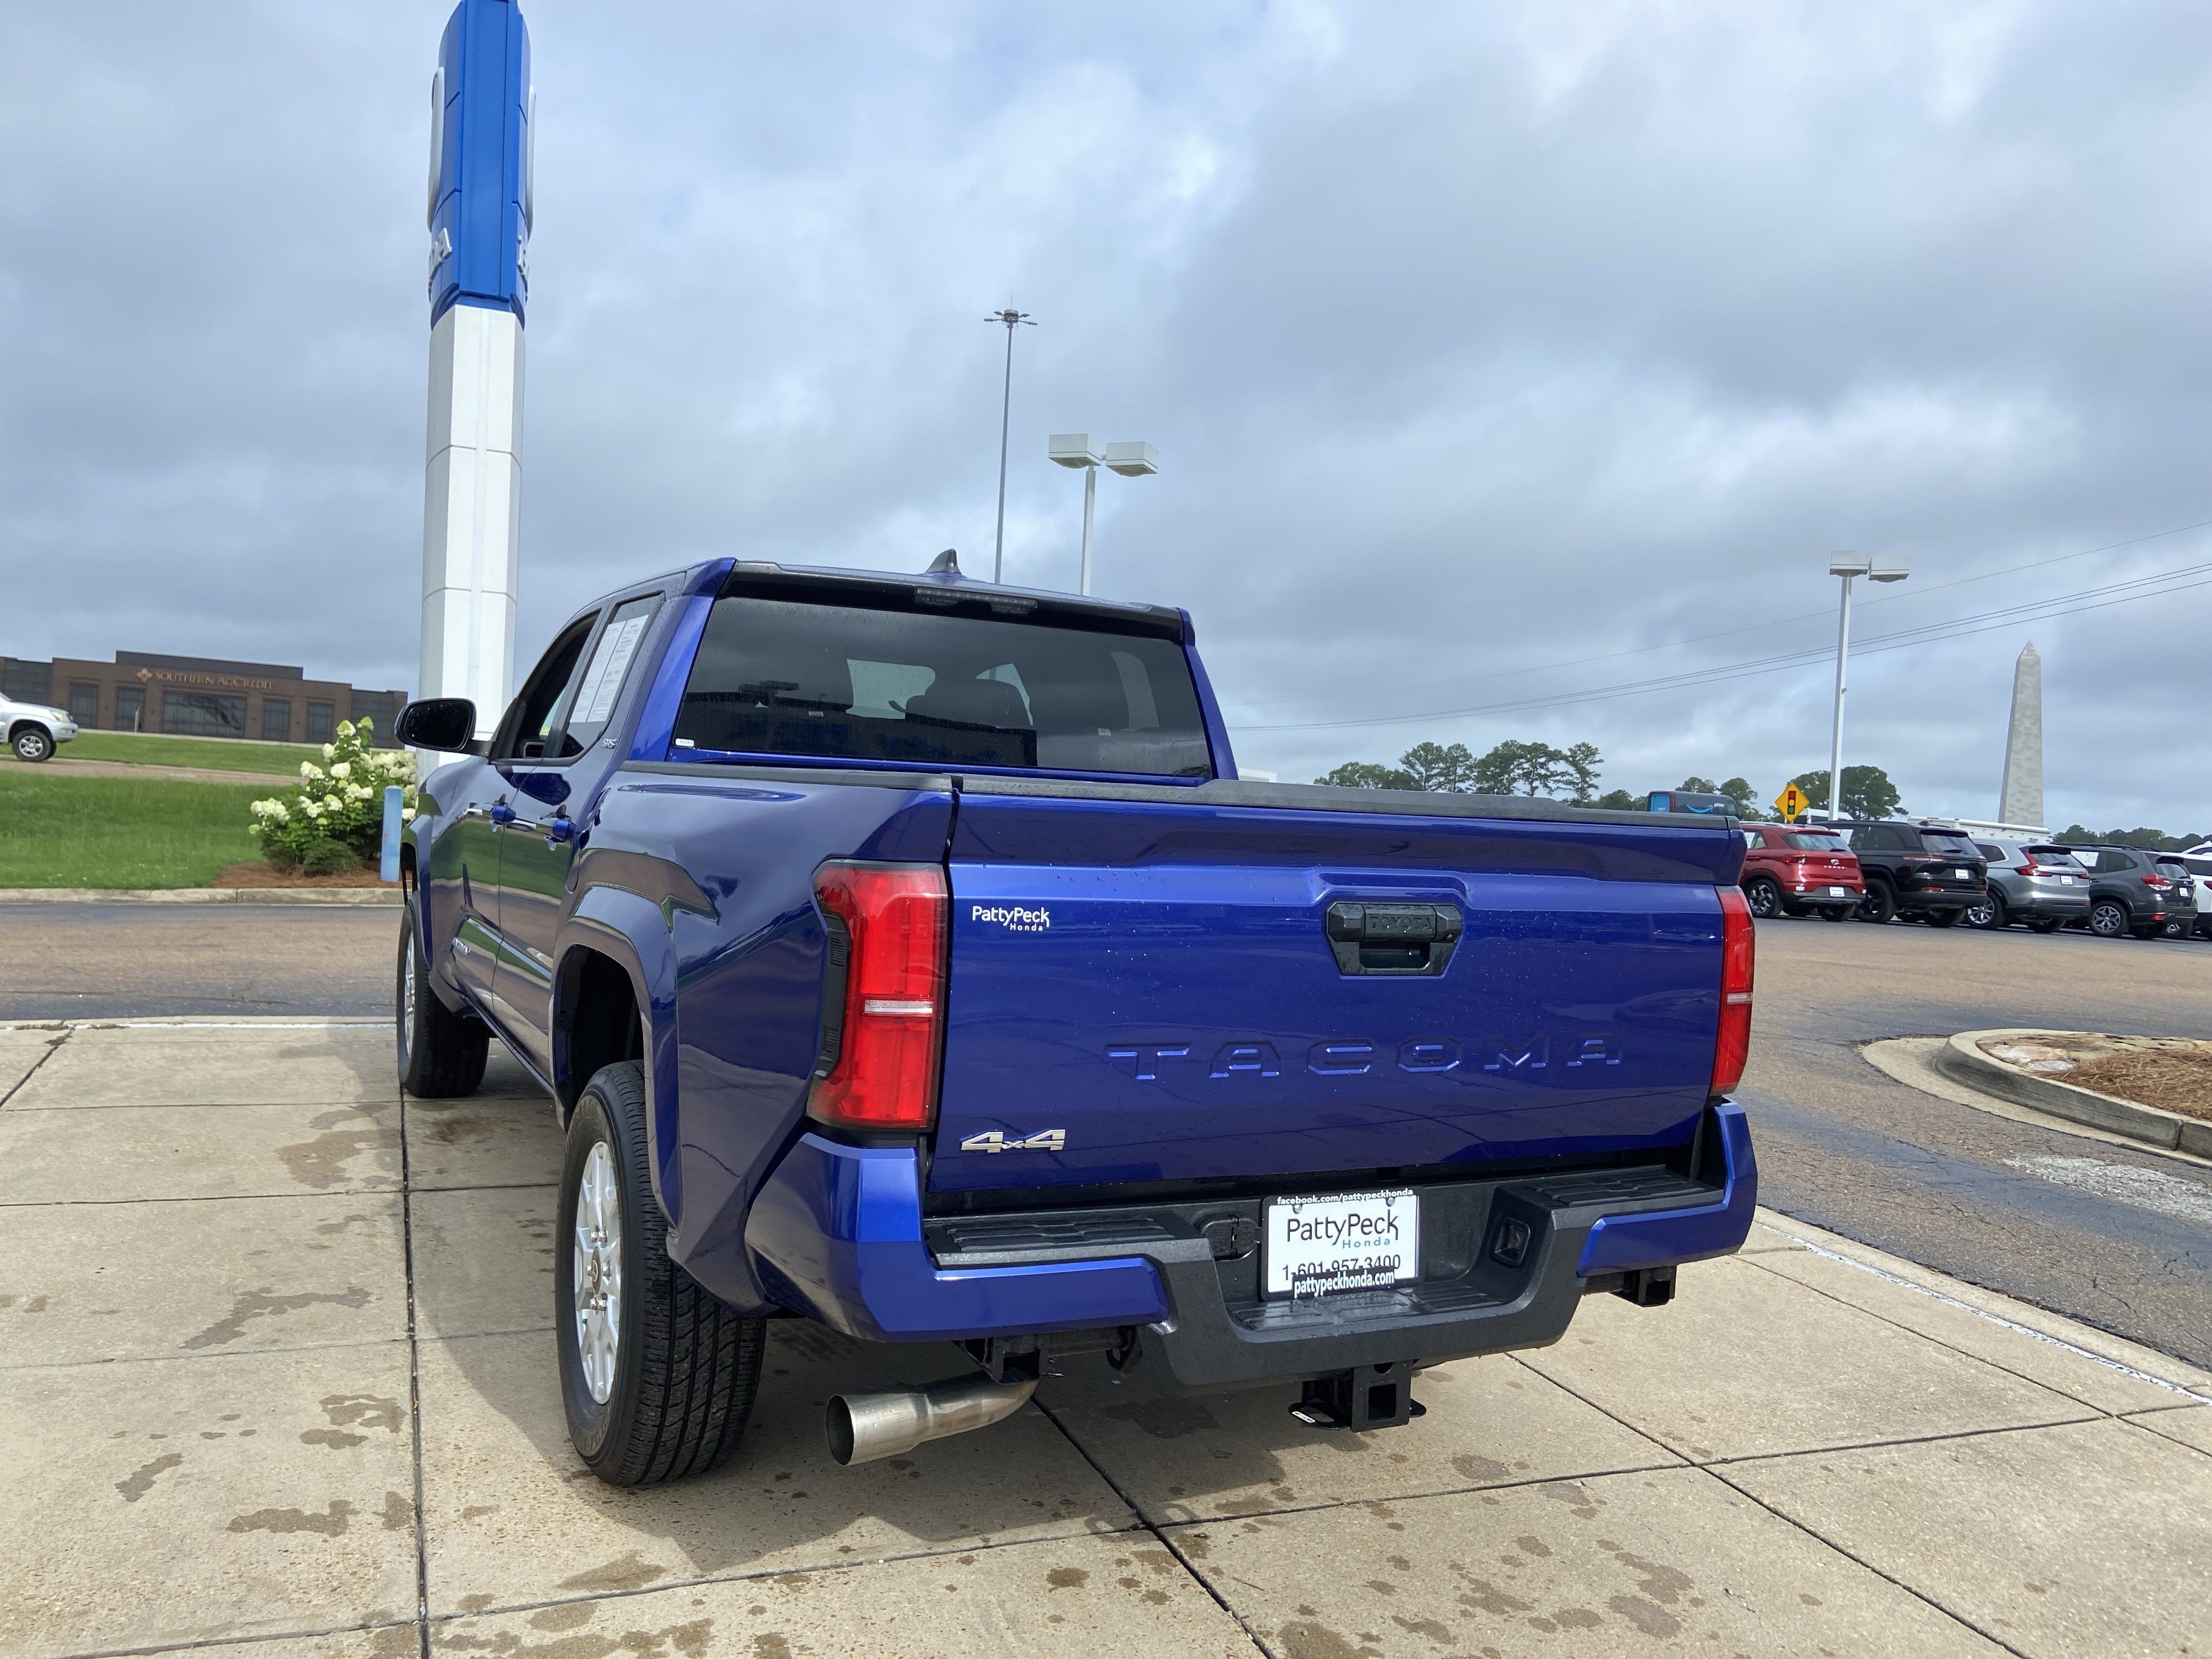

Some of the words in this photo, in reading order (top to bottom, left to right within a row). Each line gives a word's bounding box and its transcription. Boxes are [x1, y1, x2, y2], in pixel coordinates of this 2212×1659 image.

[972, 906, 1050, 927] PattyPeck
[1369, 916, 1433, 931] TOYOTA
[1105, 1034, 1624, 1080] TACOMA
[1277, 1187, 1413, 1205] facebook.com/pattypeckhonda
[1286, 1209, 1399, 1246] PattyPeck
[1342, 1237, 1391, 1249] Honda
[1282, 1254, 1401, 1280] 1-601-957-3400
[1294, 1269, 1395, 1299] pattypeckhonda.com
